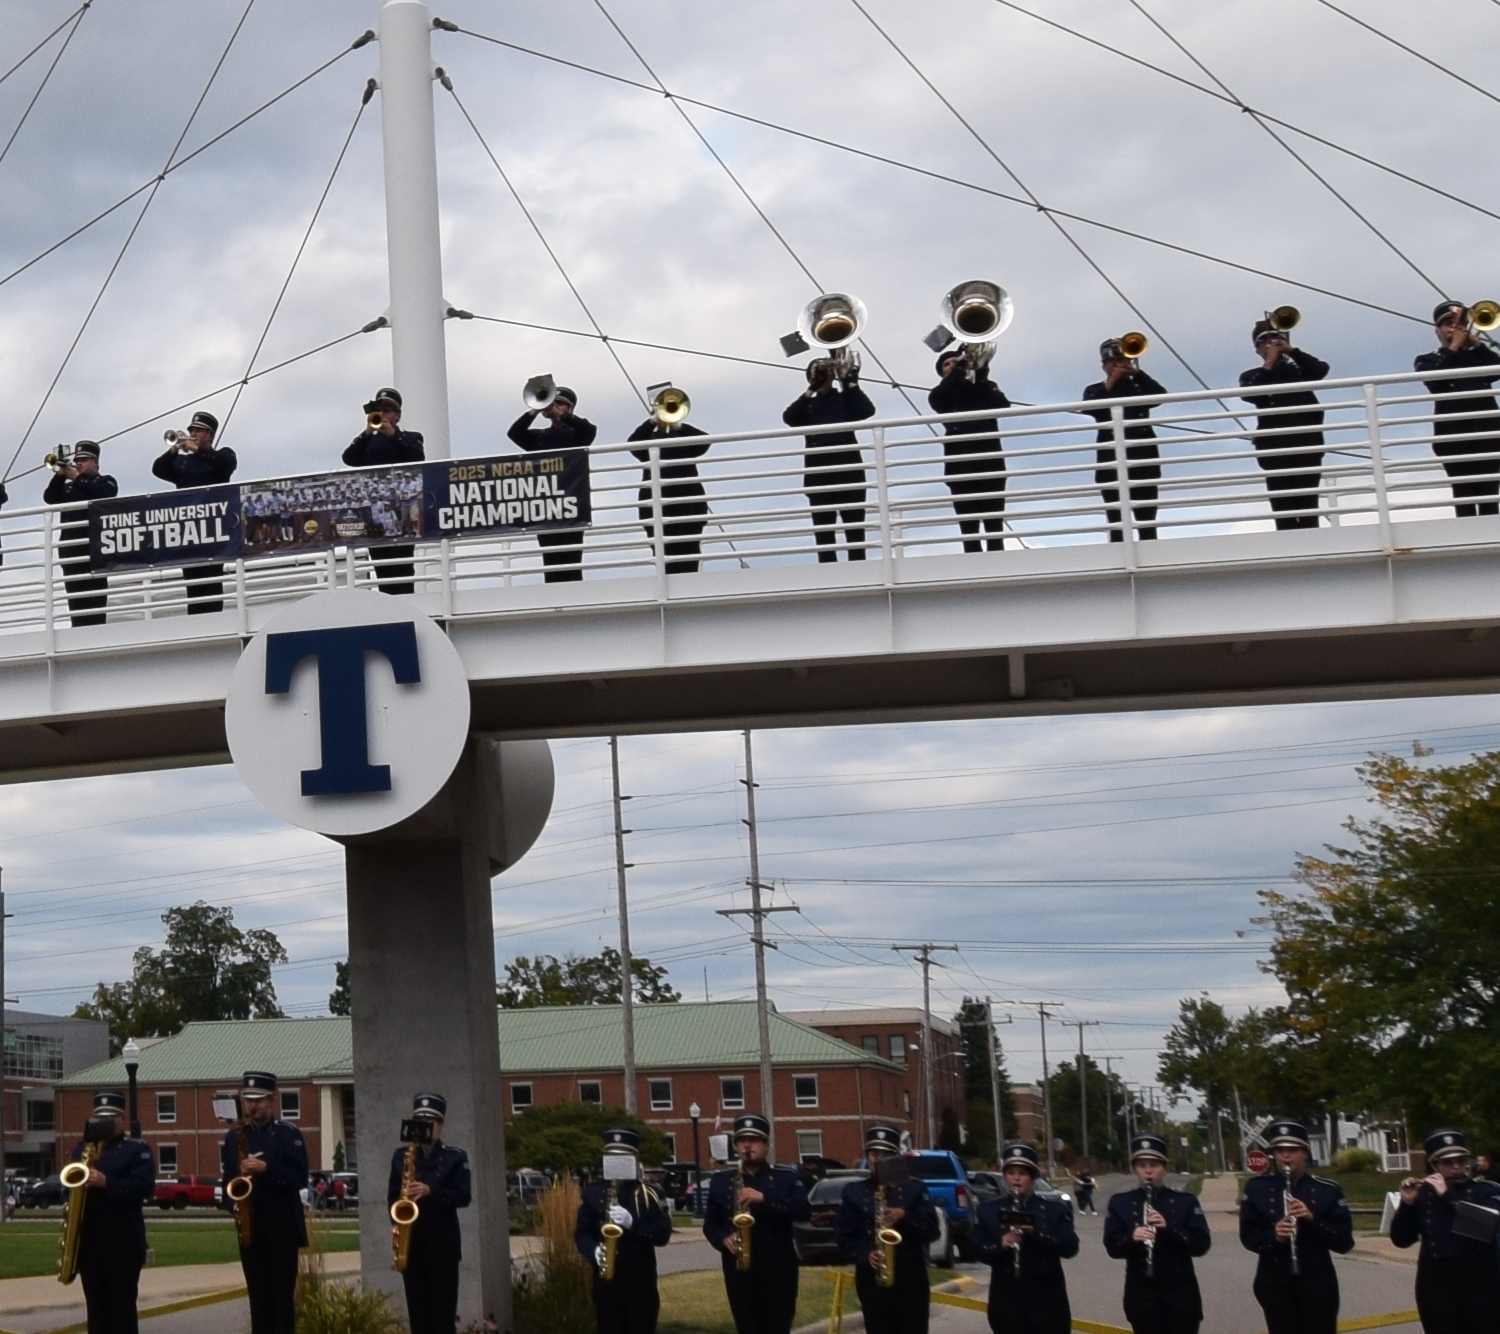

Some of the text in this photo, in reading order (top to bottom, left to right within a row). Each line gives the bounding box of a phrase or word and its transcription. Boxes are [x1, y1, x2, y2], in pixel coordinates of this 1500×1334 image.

[449, 465, 486, 481] 2025
[491, 460, 534, 477] NCAA
[449, 475, 565, 505] NATIONAL
[100, 501, 229, 529] TRINE UNIVERSITY
[438, 496, 578, 529] CHAMPIONS
[100, 518, 230, 554] SOFTBALL
[264, 621, 421, 797] T
[1247, 1157, 1267, 1166] STOP
